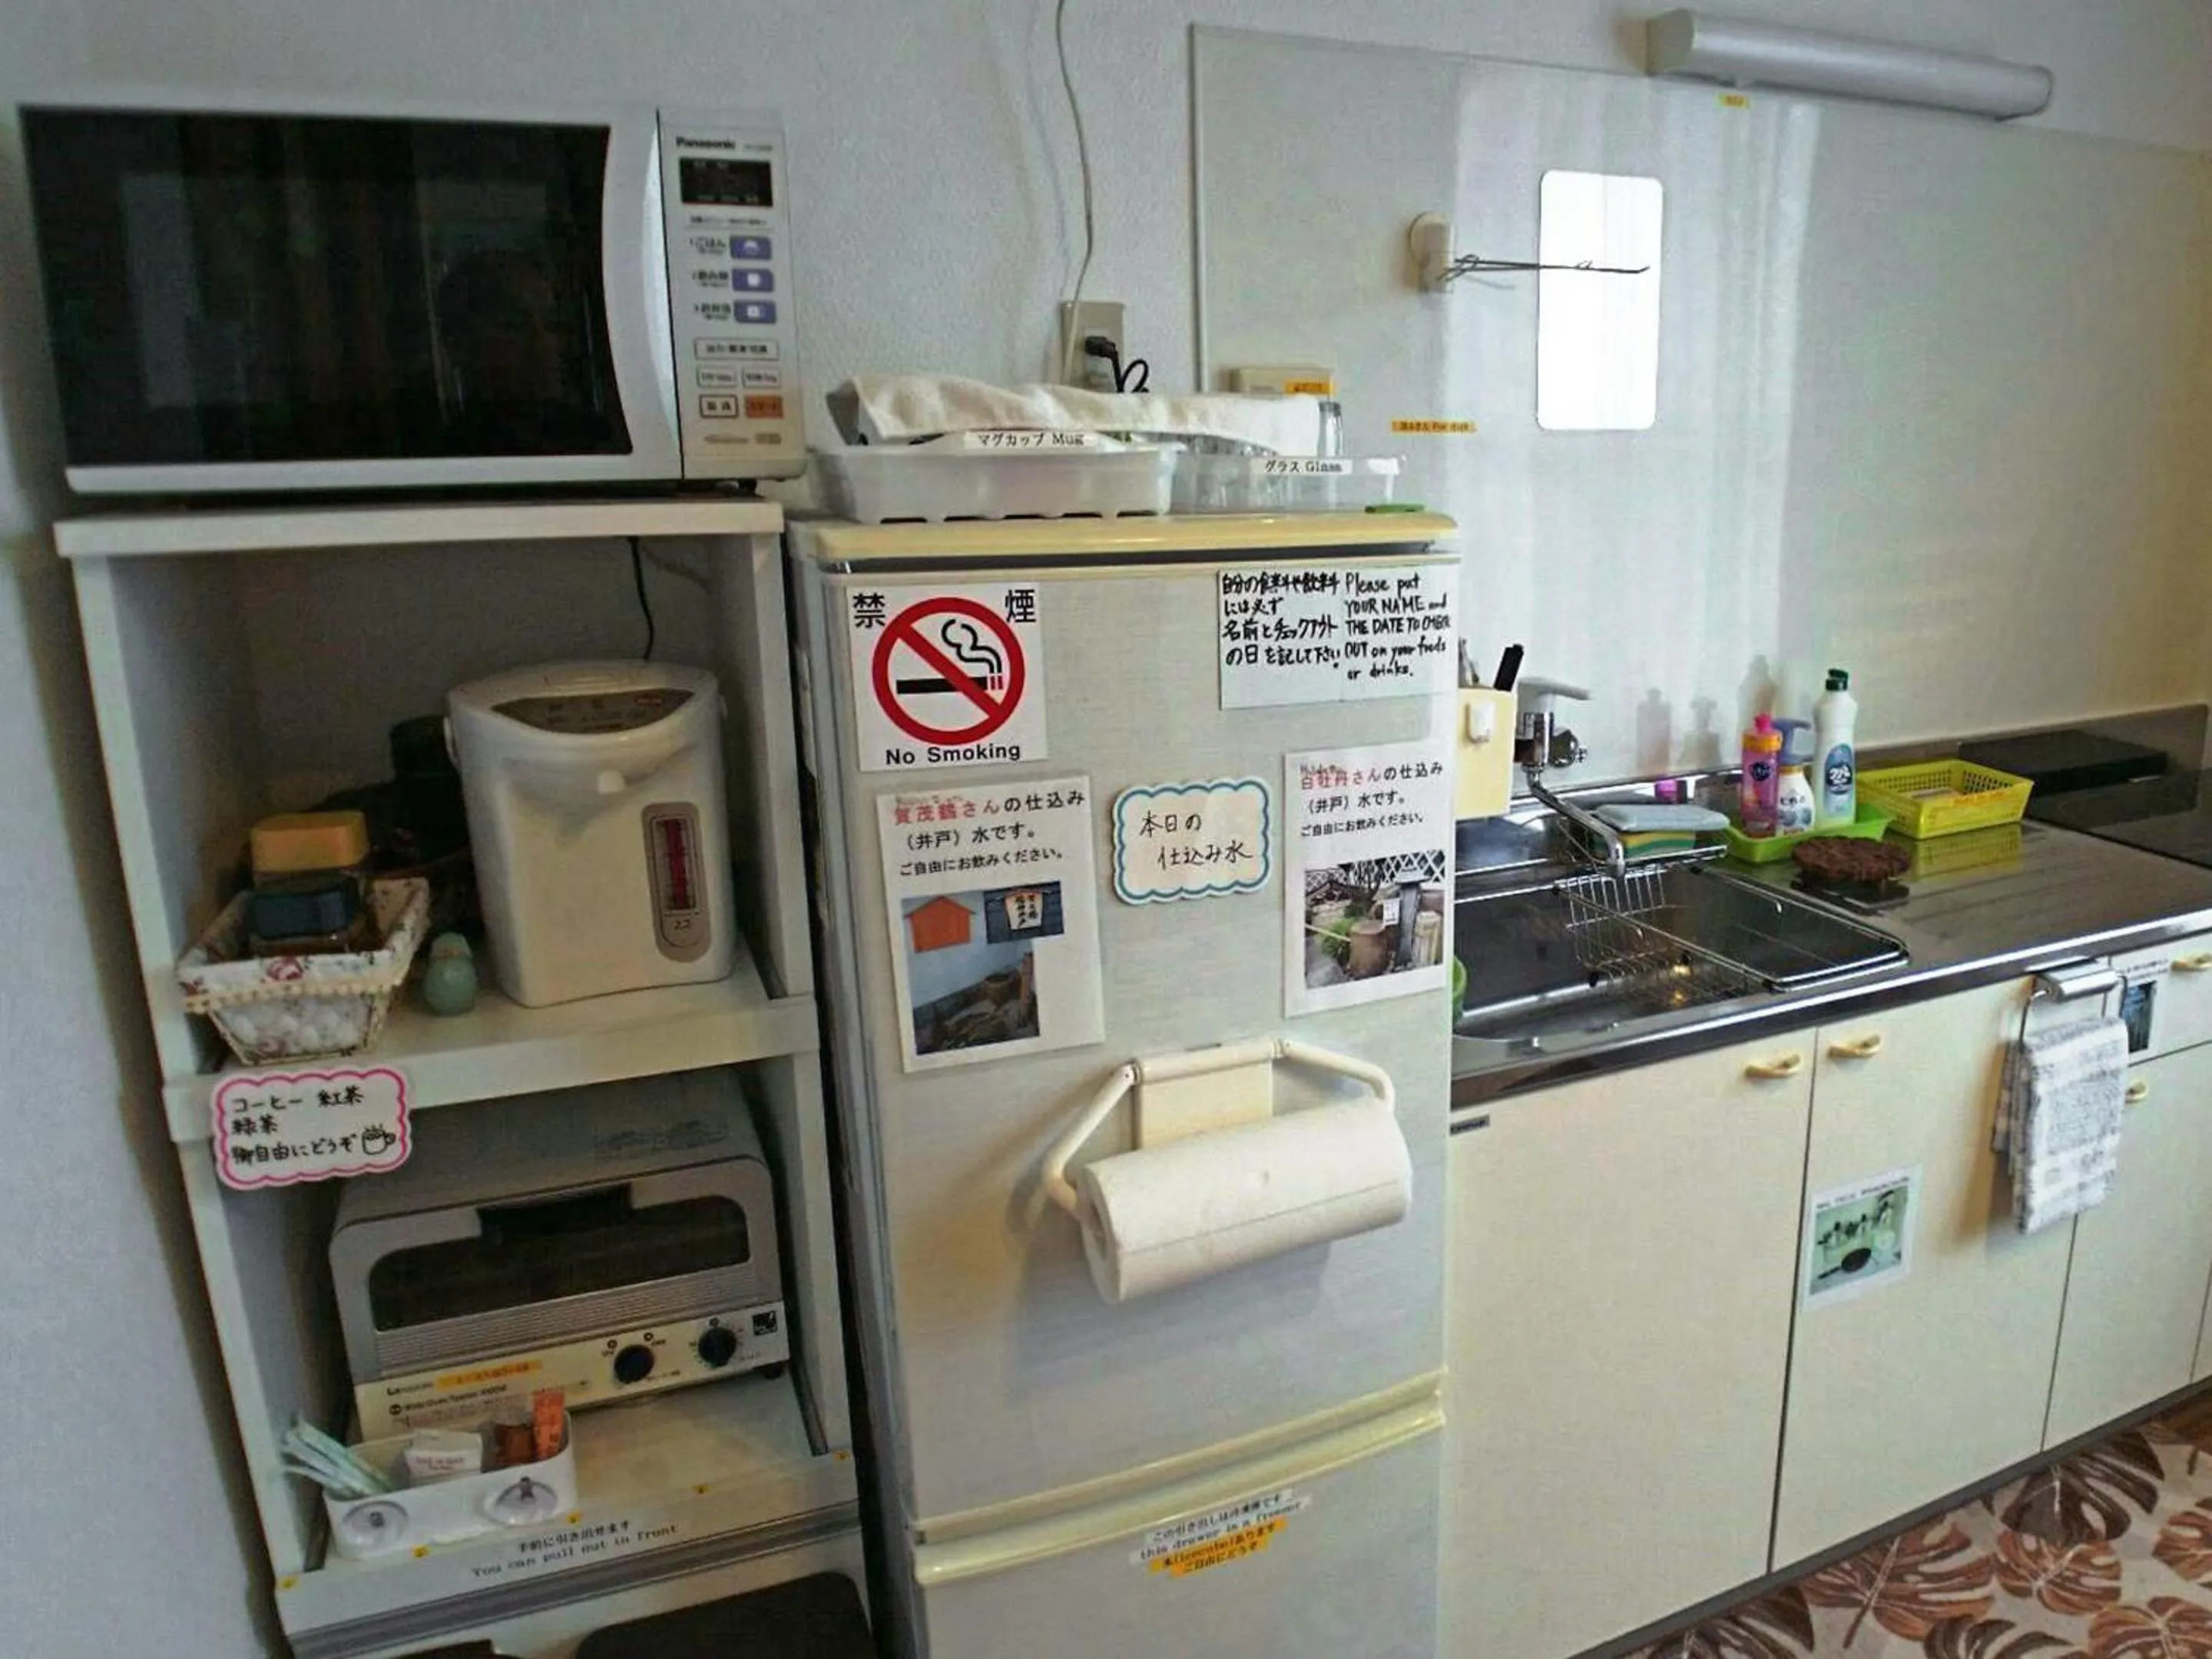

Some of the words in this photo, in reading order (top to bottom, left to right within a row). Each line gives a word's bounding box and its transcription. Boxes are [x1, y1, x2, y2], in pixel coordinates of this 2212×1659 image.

[676, 136, 735, 150] Panasonic
[979, 432, 1044, 447] マグカップ
[1052, 433, 1084, 446] Mug
[1266, 459, 1300, 473] グラス
[1346, 571, 1390, 597] Please
[1397, 571, 1420, 600] put
[853, 593, 886, 628] 禁
[1005, 589, 1037, 624] 煙
[1344, 597, 1379, 618] YOUR
[1382, 595, 1426, 614] NAME
[1345, 619, 1369, 637] THE
[1372, 617, 1404, 634] DATE
[1406, 617, 1421, 635] TO
[1344, 641, 1369, 659] OUT
[1371, 646, 1387, 658] on
[1391, 645, 1416, 667] your
[1347, 670, 1362, 680] or
[1369, 660, 1414, 678] drinks.
[886, 749, 916, 766] No
[927, 743, 1021, 763] Smoking
[1139, 810, 1203, 838] 本日の
[899, 846, 1064, 877] ご自由にお飲みください。
[1157, 839, 1253, 870] 仕込み水
[233, 1094, 304, 1113] コーヒー
[316, 1084, 366, 1107] 紅茶
[472, 1565, 502, 1577] You
[508, 1558, 535, 1570] can
[543, 1548, 575, 1563] pull
[637, 1525, 678, 1541] front
[1141, 1545, 1168, 1560] this
